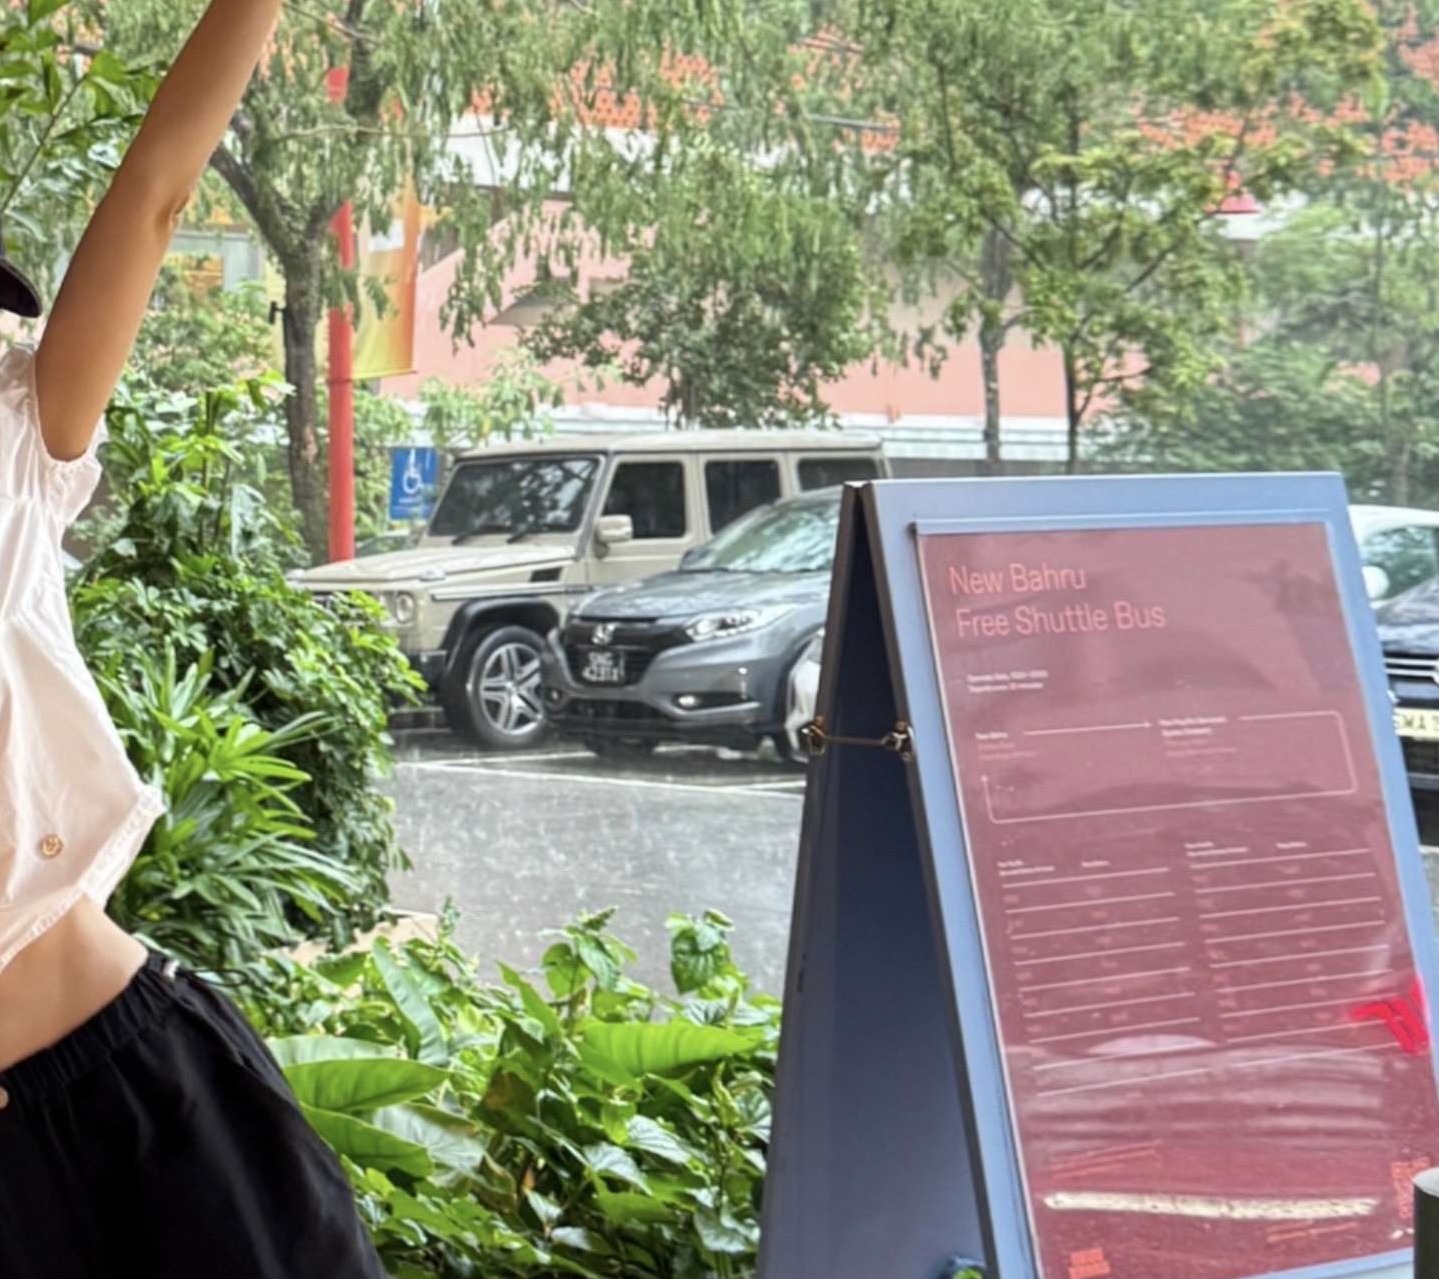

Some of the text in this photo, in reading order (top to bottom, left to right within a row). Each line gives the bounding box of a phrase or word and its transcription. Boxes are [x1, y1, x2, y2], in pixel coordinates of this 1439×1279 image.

[948, 562, 1087, 595] New Bahru
[956, 600, 1167, 638] Free Shuttle Bus
